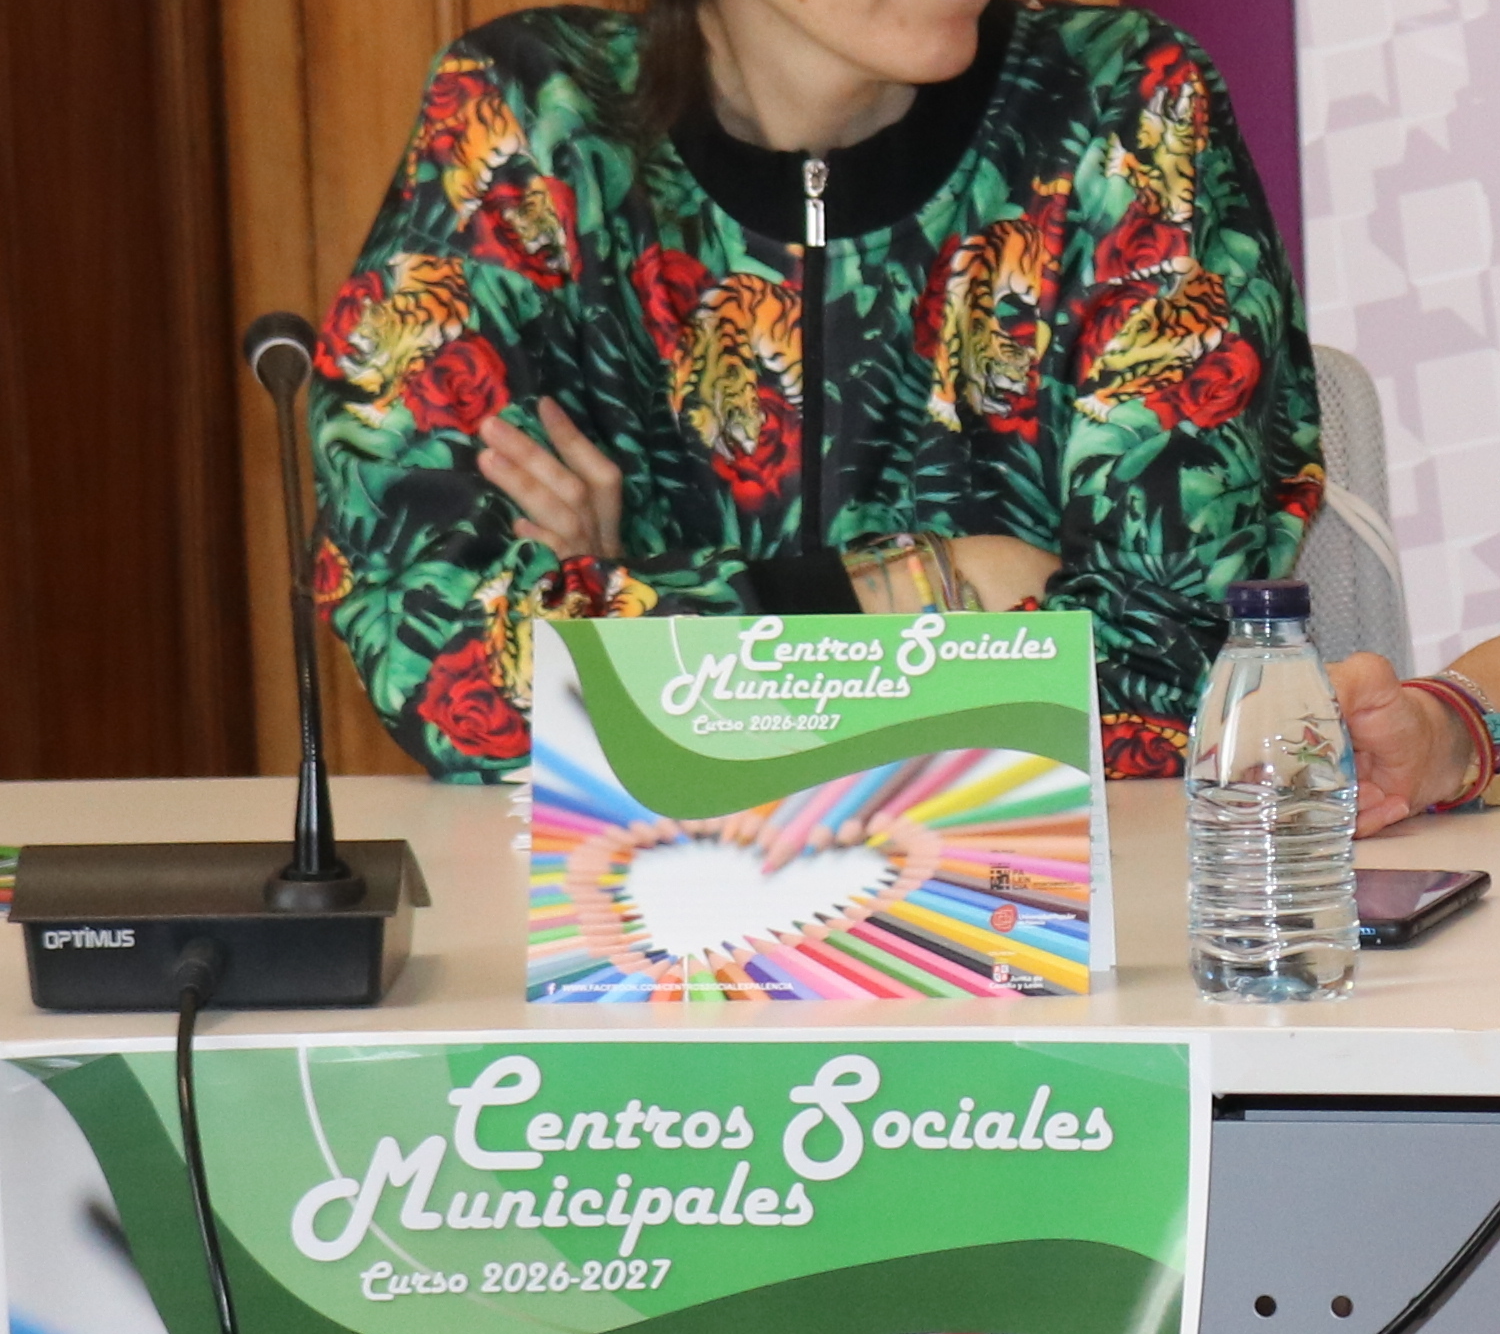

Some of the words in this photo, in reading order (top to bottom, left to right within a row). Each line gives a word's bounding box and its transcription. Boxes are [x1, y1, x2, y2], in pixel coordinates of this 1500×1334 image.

[738, 615, 884, 671] Centros
[896, 613, 1057, 676] Sociales
[661, 652, 911, 716] Municipales
[693, 713, 743, 735] Curso
[749, 712, 841, 733] 2026-2027
[42, 924, 136, 950] OPTIMUS
[448, 1055, 754, 1171] Centros
[782, 1054, 1114, 1181] Sociales
[289, 1134, 815, 1262] Municipales
[360, 1261, 469, 1302] Curso
[480, 1258, 672, 1293] 2026-2027
